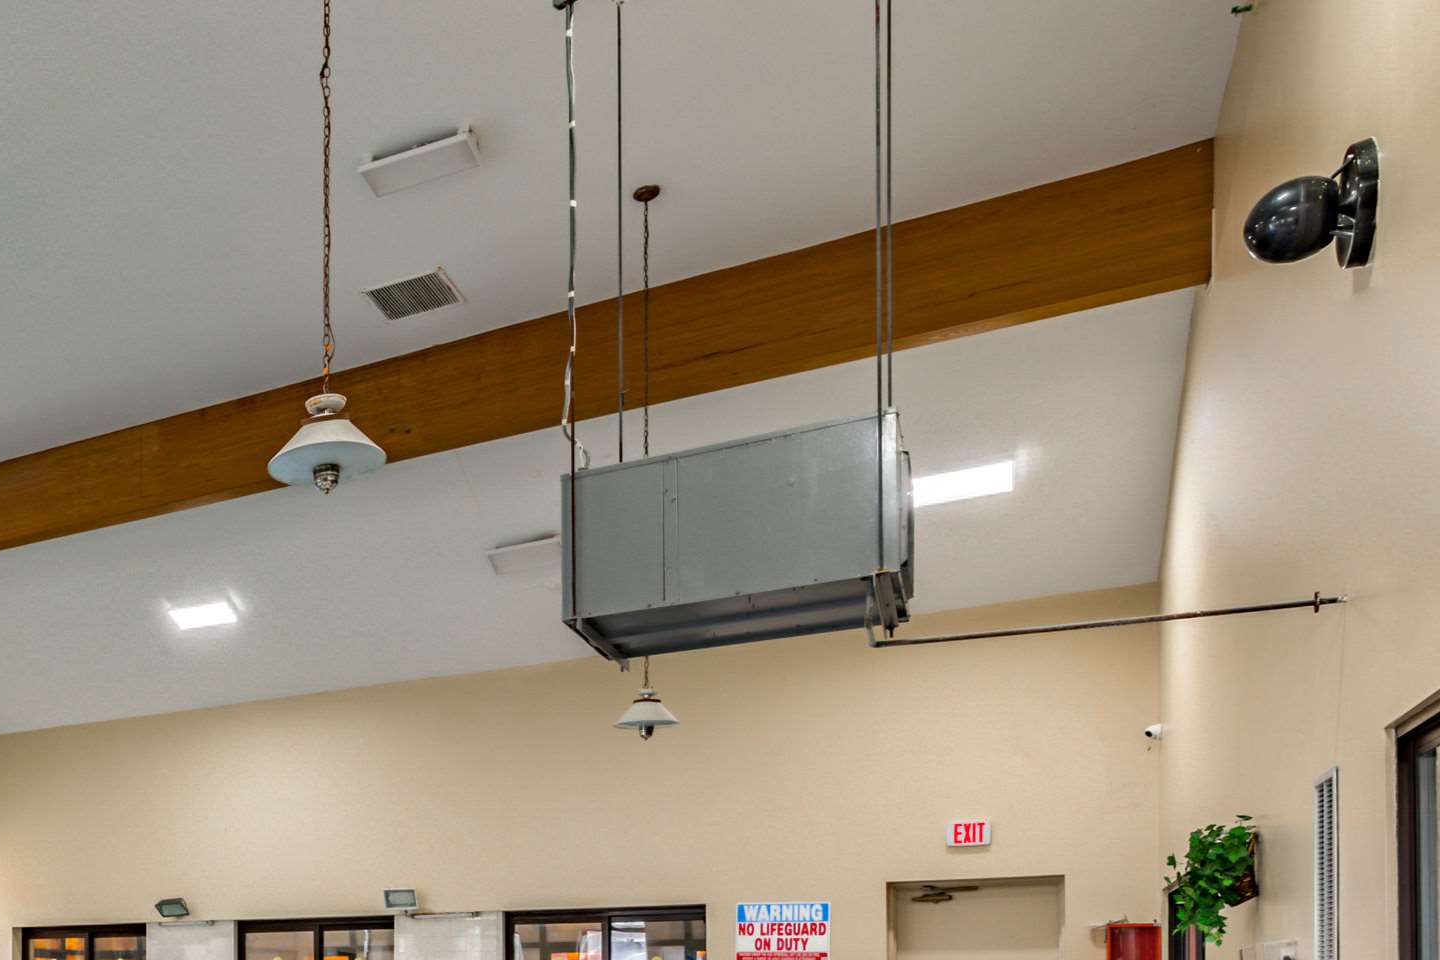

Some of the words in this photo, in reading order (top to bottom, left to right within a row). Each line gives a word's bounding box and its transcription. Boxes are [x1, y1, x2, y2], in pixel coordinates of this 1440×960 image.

[954, 822, 985, 844] EXIT
[744, 903, 824, 922] WARNING
[738, 922, 755, 936] NO
[760, 922, 827, 936] LIFEGUARD
[754, 938, 771, 951] ON
[777, 938, 809, 951] DUTY
